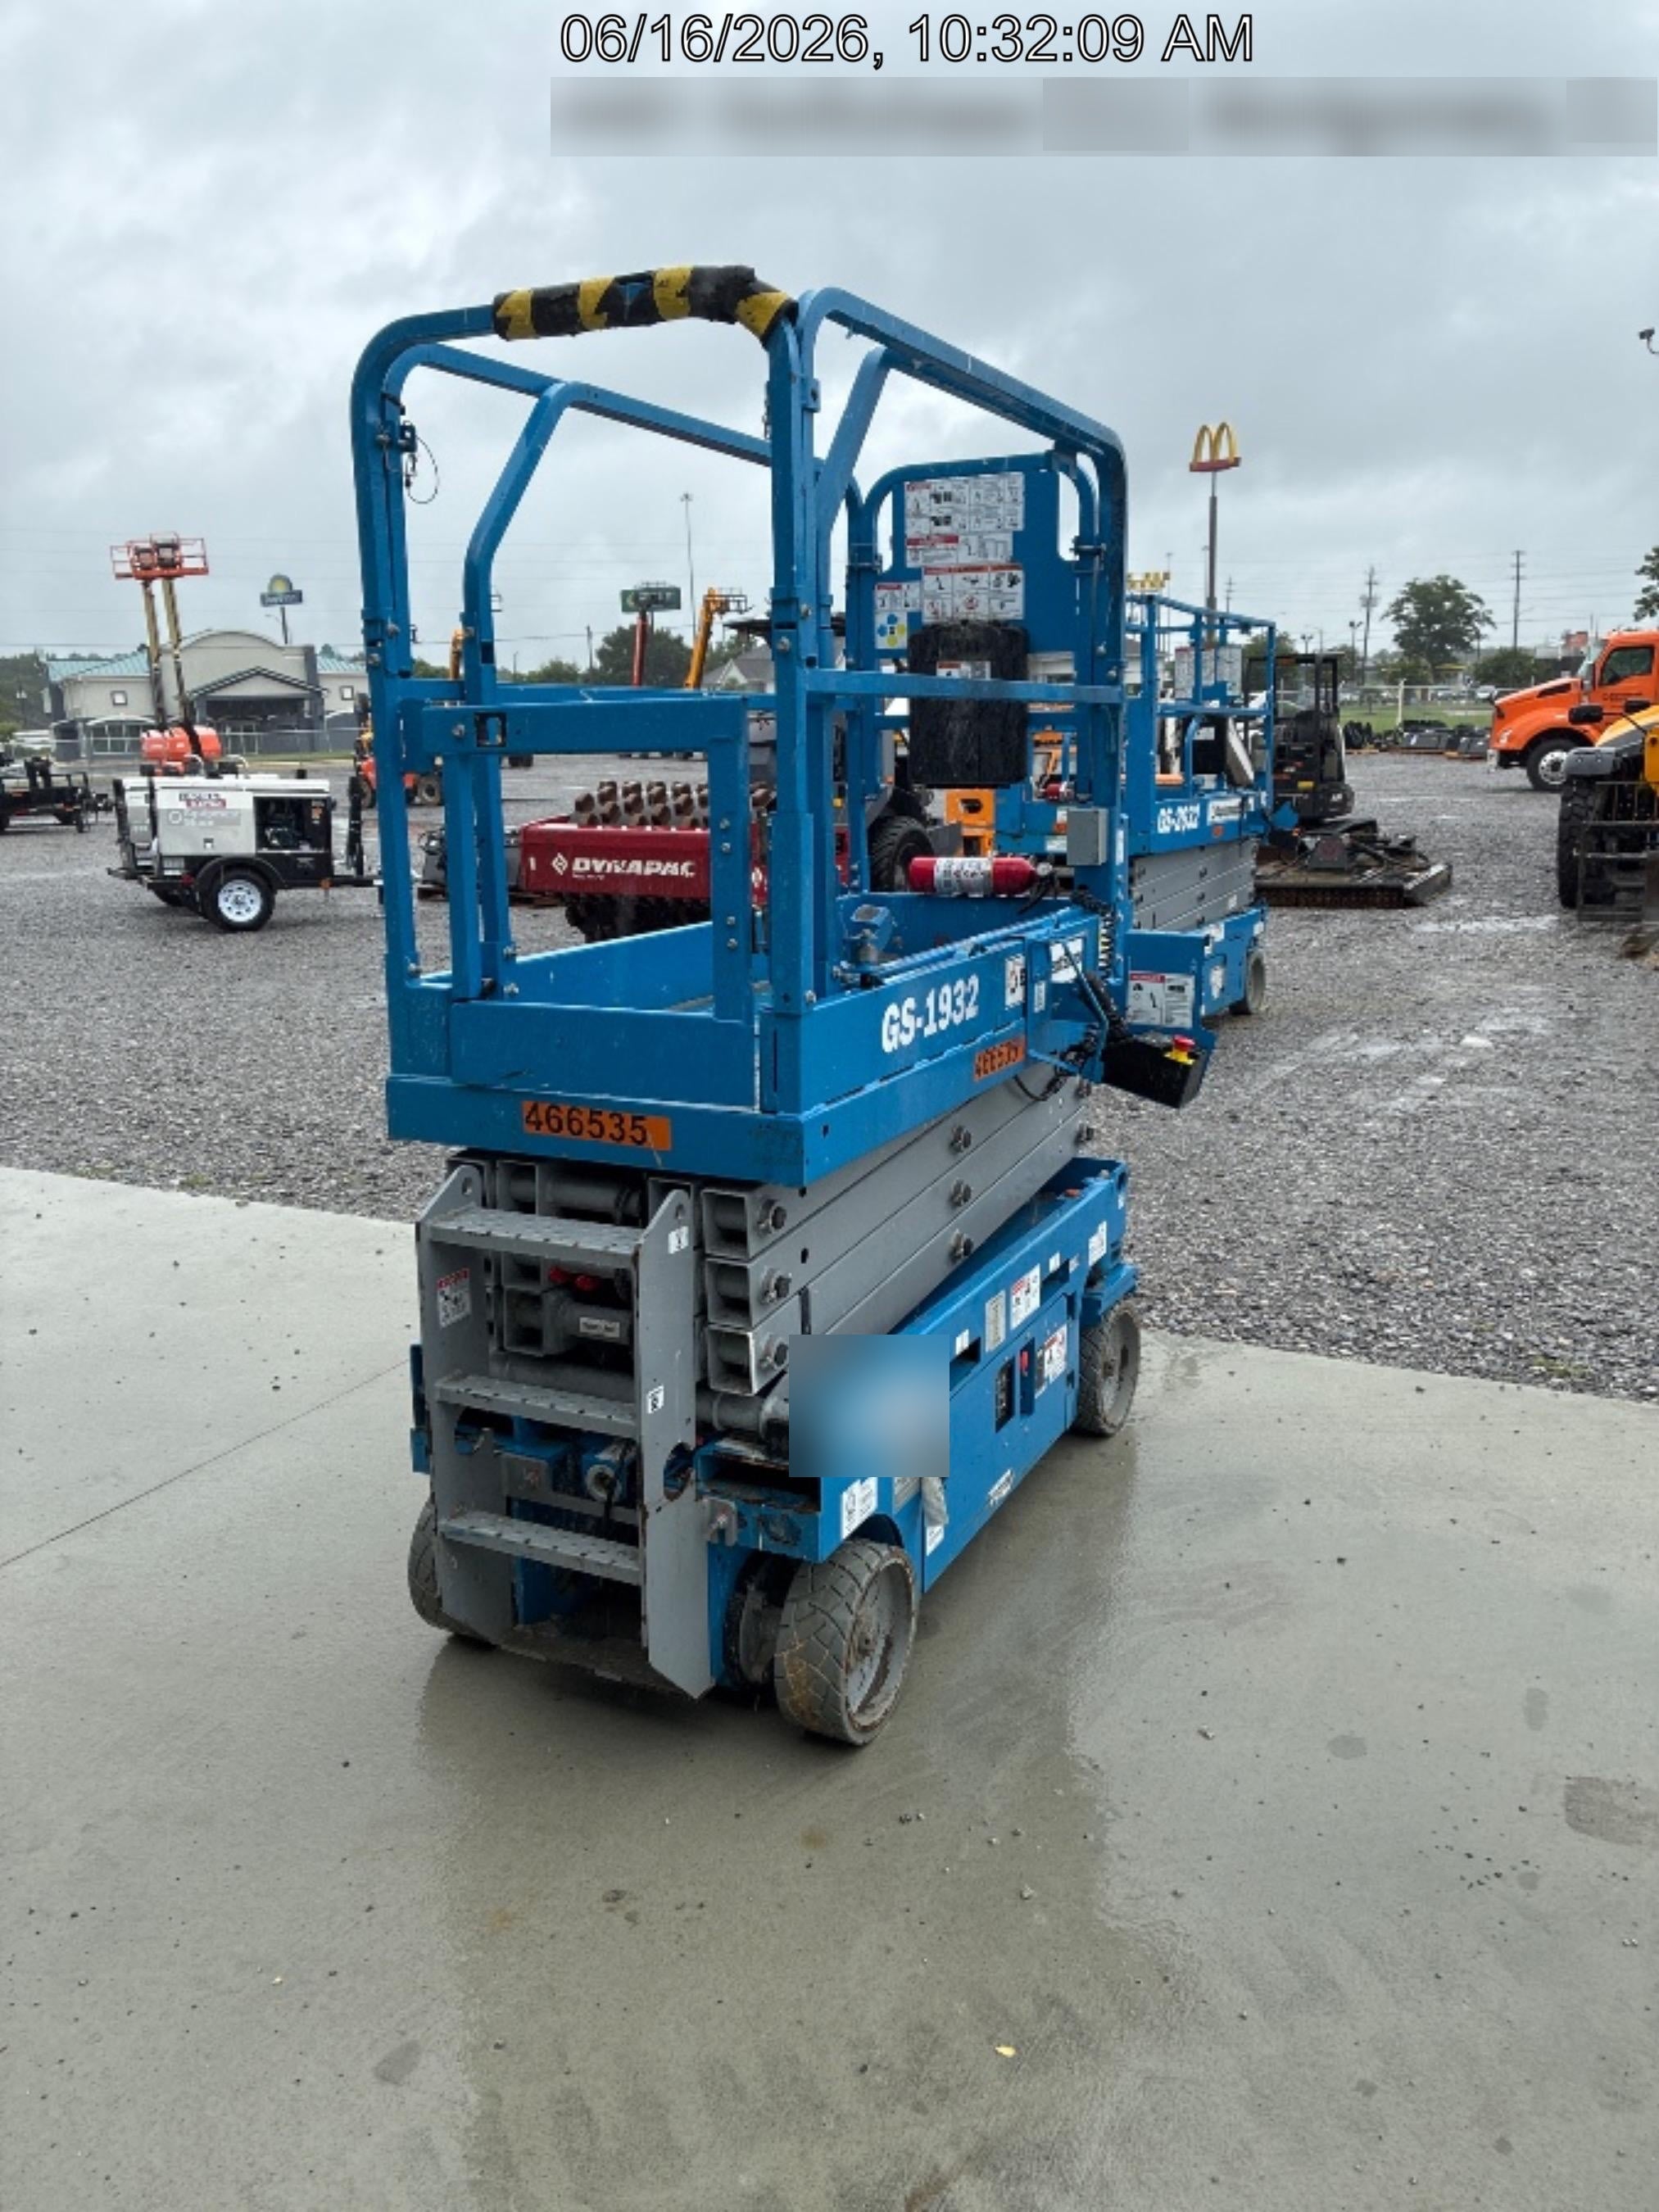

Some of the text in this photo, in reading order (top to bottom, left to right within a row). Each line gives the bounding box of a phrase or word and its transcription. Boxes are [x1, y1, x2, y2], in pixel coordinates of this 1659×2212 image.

[573, 857, 696, 877] DYNAPAC
[882, 973, 979, 1054] GS-1932
[524, 1102, 650, 1145] 466535
